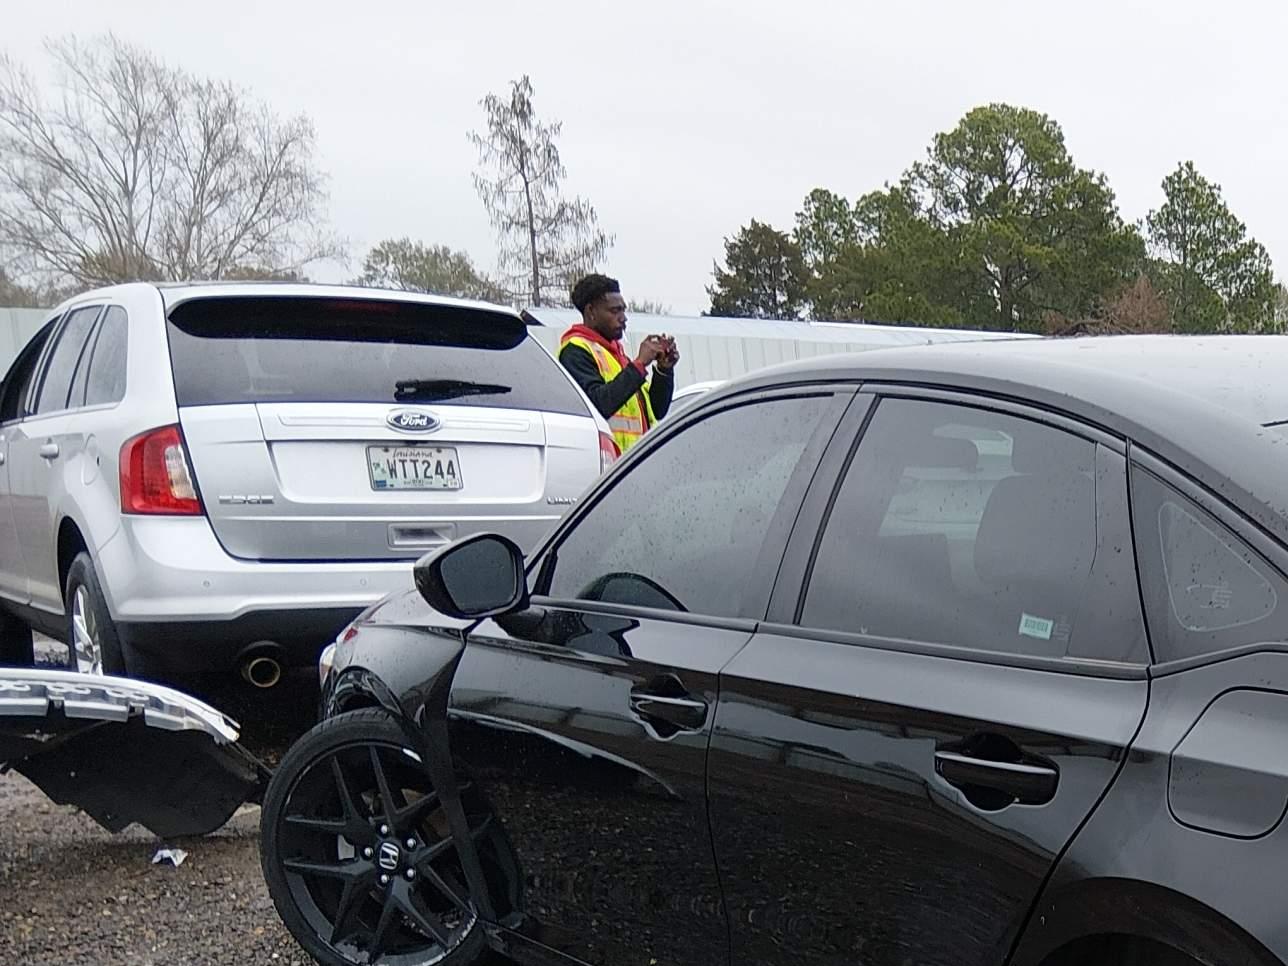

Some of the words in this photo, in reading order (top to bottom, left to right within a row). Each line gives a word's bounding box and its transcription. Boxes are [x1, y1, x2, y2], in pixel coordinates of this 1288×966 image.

[400, 413, 427, 426] Ford
[393, 447, 433, 458] Louisiana
[386, 458, 456, 479] WTT244
